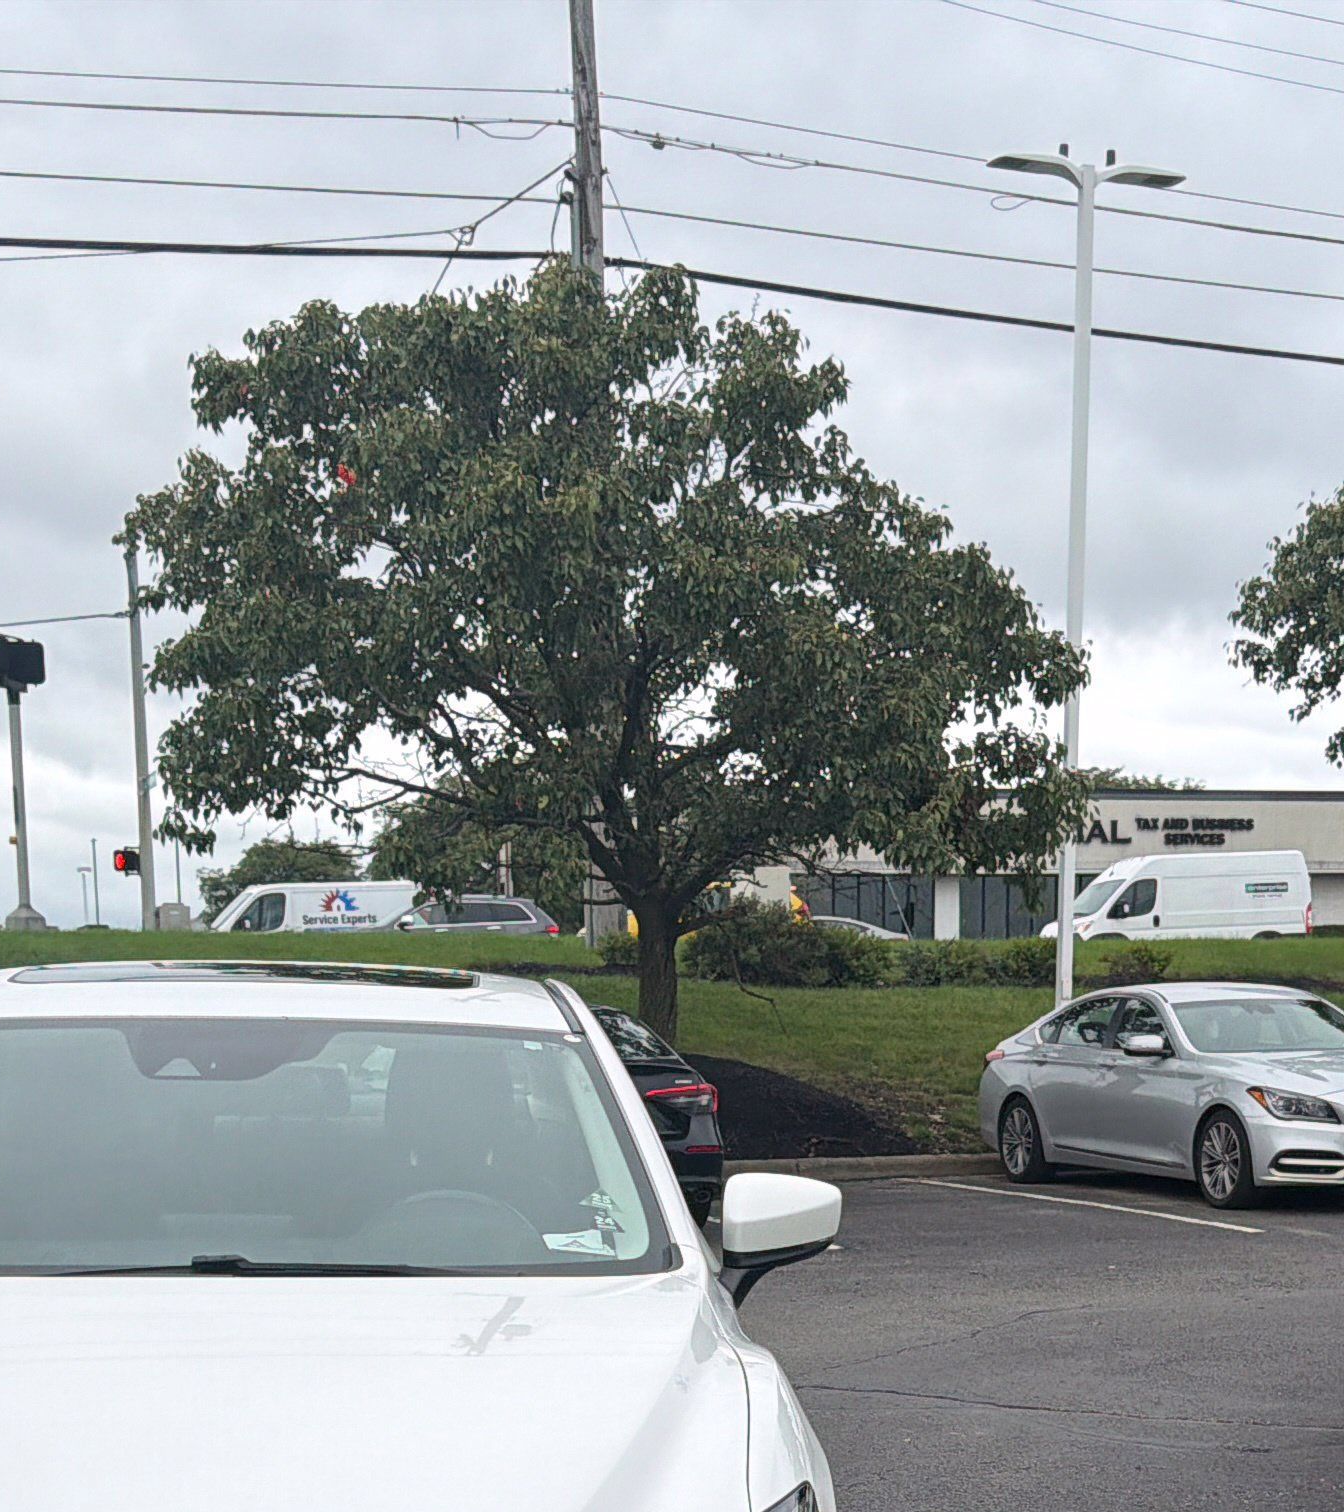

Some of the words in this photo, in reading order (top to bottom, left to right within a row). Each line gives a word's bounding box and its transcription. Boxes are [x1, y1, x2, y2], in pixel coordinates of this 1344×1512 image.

[1135, 817, 1159, 831] TAX
[1162, 817, 1189, 831] AND
[1192, 817, 1255, 831] BUSINESS
[1164, 833, 1225, 845] SERVICES
[302, 914, 339, 925] Service
[341, 913, 377, 925] Experts
